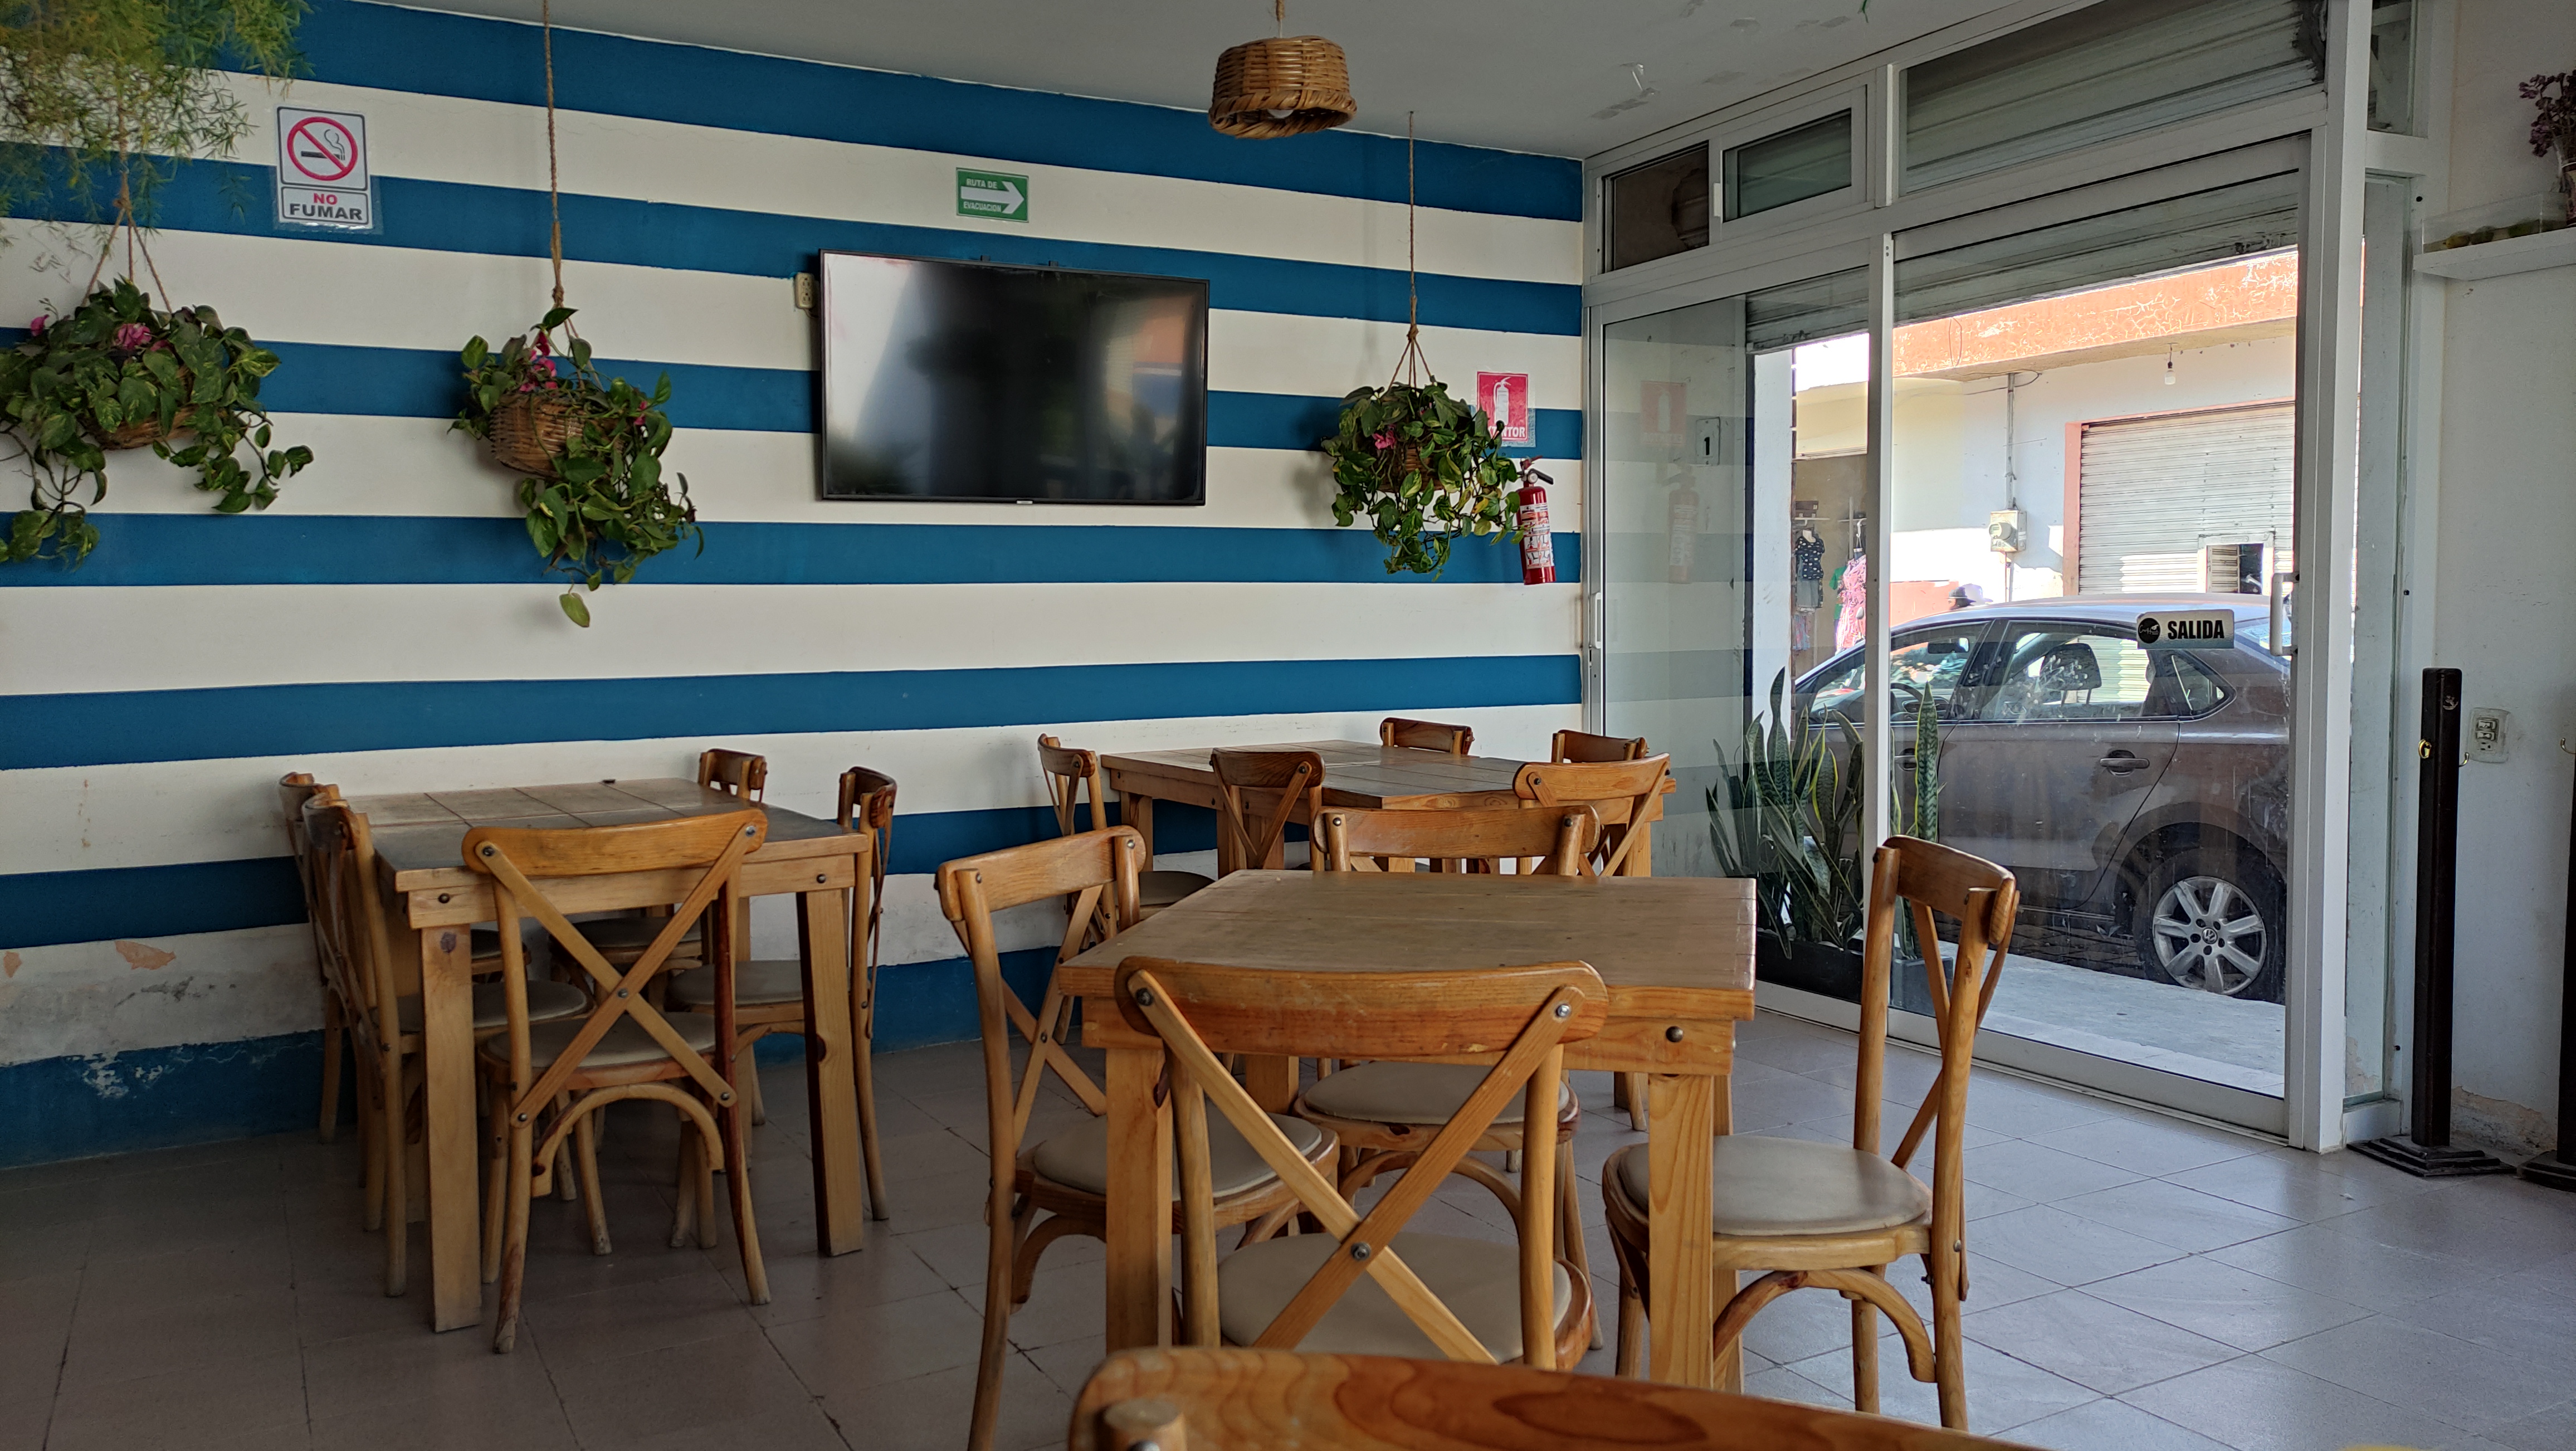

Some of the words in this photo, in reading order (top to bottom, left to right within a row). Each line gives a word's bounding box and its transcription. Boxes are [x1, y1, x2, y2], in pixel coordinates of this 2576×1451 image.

[966, 178, 986, 188] RUTA
[314, 193, 338, 205] NO
[290, 203, 362, 221] FUMAR
[2168, 620, 2224, 640] SALIDA
